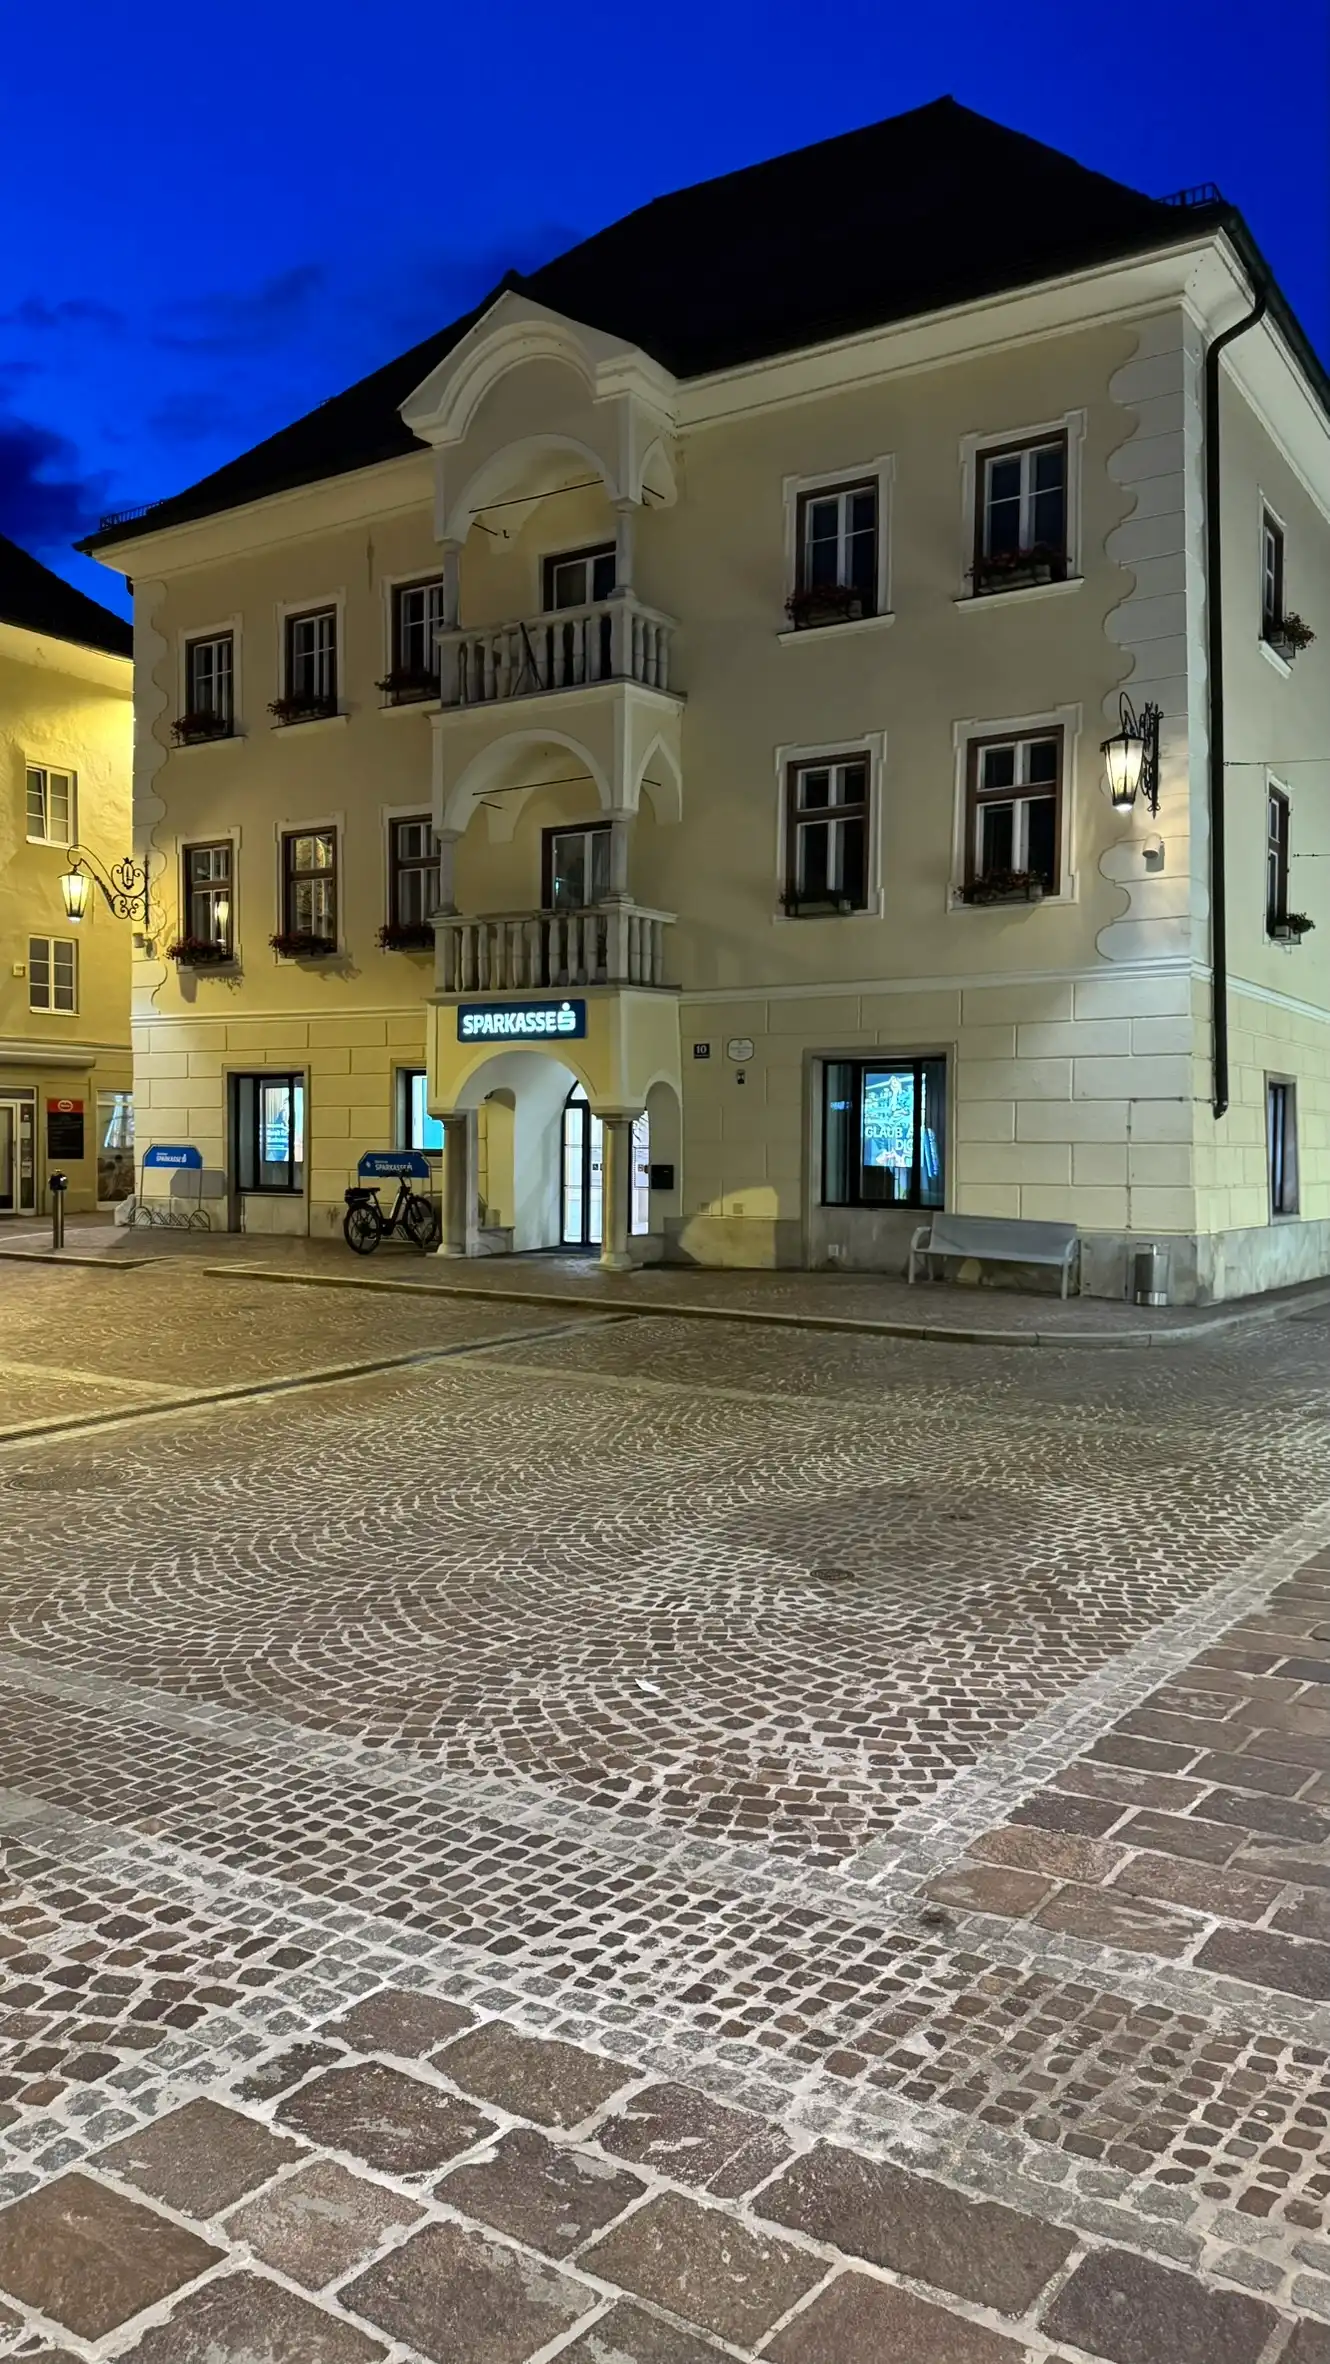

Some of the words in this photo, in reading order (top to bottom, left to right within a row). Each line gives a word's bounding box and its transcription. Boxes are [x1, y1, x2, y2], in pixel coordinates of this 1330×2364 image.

[463, 1011, 557, 1034] SPARKASSE
[696, 1045, 707, 1054] 10
[865, 1126, 903, 1138] GLAUB
